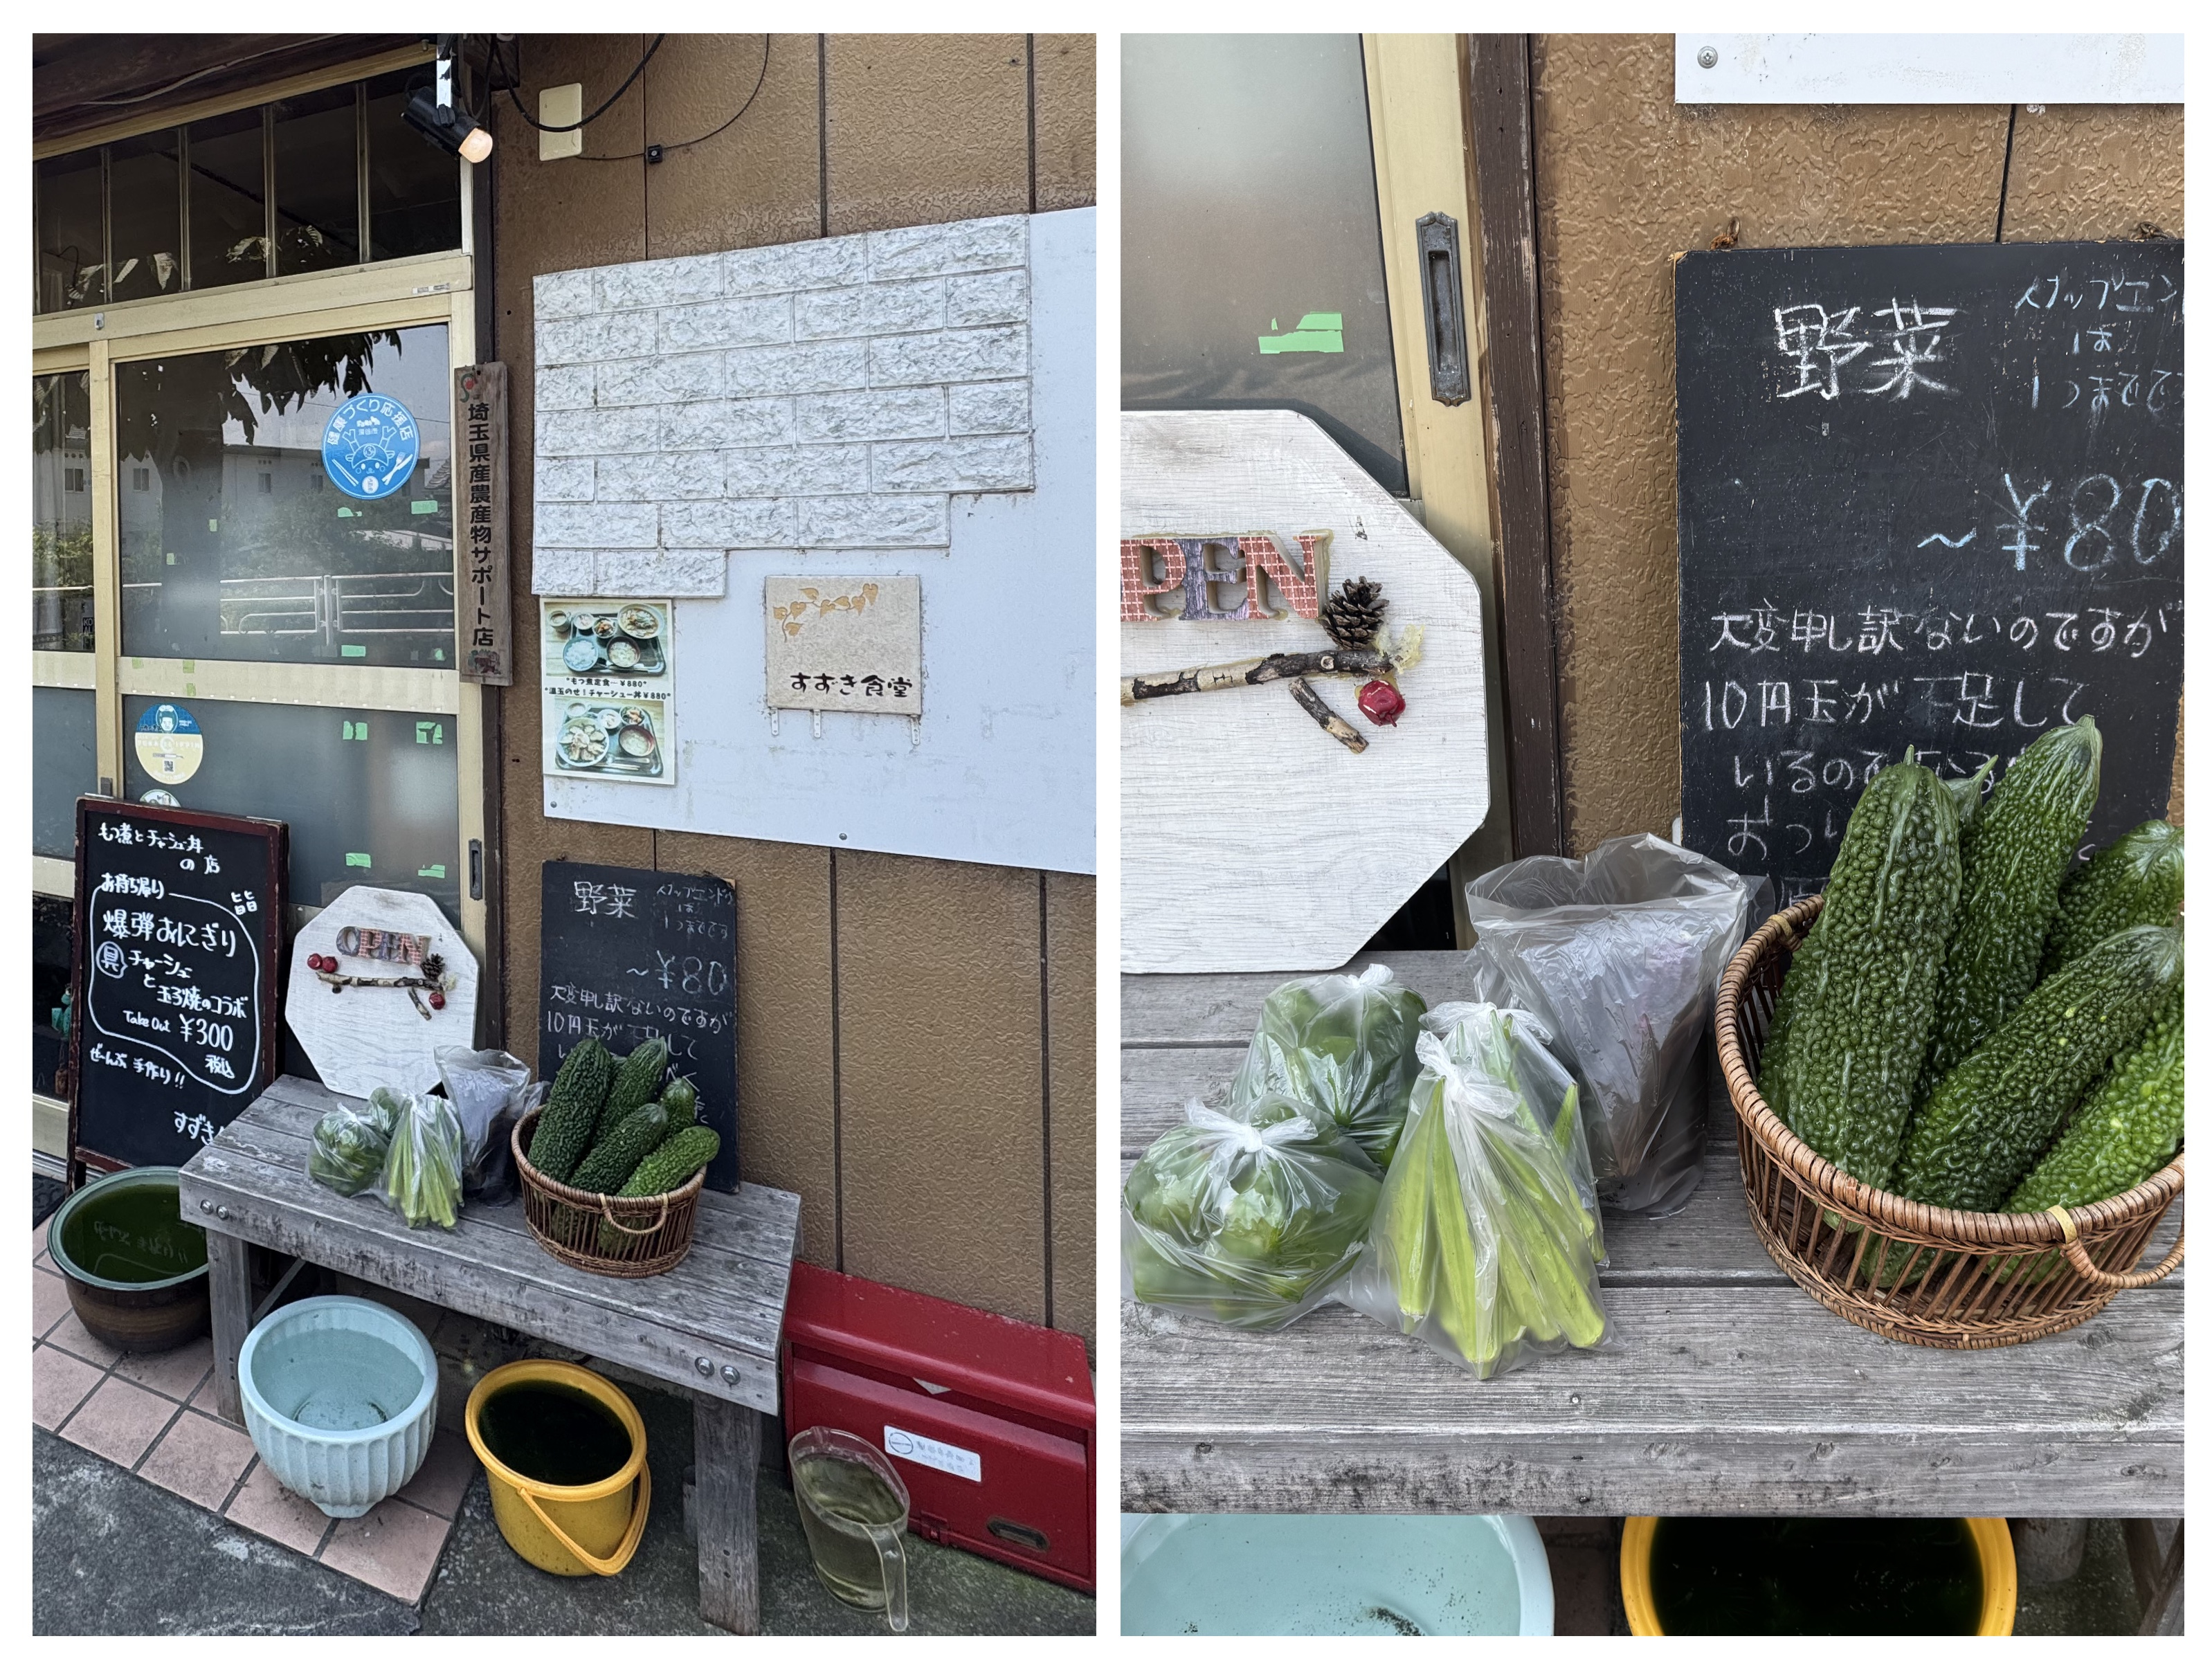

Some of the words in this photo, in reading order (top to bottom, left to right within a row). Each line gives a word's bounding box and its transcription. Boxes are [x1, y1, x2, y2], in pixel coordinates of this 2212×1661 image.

[2014, 270, 2184, 313] スナップエン
[1775, 296, 1964, 400] 野菜
[2031, 368, 2184, 415] 1つまでで
[468, 403, 494, 648] 埼玉県産農産物サポート店
[1120, 534, 1325, 622] PEN
[1710, 598, 2184, 659] 大変申し訳ないのですが
[790, 671, 913, 698] すずき食堂
[1705, 671, 2089, 729] 10円玉が不足して
[98, 822, 204, 853] もつ煮とチャーシュー丼
[101, 872, 165, 900] お持ち帰り
[574, 880, 638, 918] 野菜
[103, 909, 236, 957] 爆弾おにぎり
[336, 926, 432, 965] OPEN
[101, 945, 121, 972] 具
[143, 973, 156, 988] と
[156, 985, 249, 1019] 玉子焼のコラボ
[550, 981, 734, 1035] 大変申し訳ないのですが
[123, 1010, 149, 1028] Take
[151, 1017, 171, 1033] Out
[179, 1013, 233, 1052] ¥300
[205, 1054, 236, 1079] 税込
[174, 1111, 224, 1146] すずき
